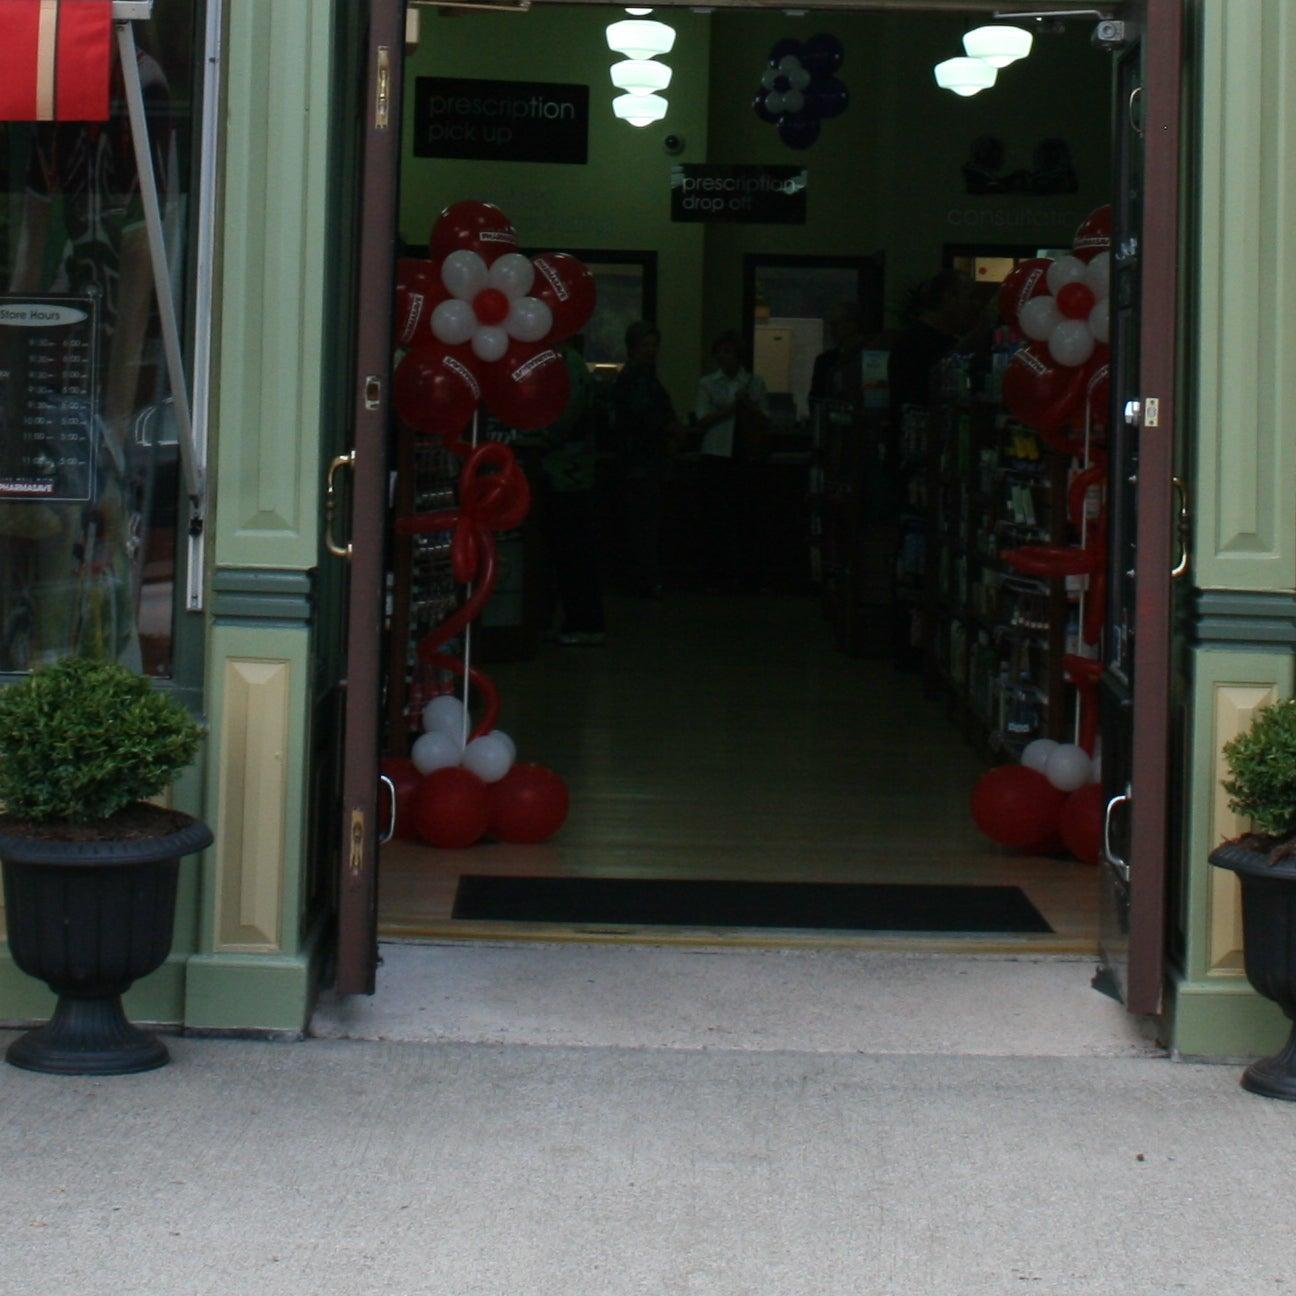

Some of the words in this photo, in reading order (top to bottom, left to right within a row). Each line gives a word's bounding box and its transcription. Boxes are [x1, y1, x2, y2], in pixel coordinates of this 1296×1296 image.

[429, 95, 576, 120] prescription
[429, 121, 477, 145] pick
[482, 126, 513, 145] up
[682, 175, 795, 194] prescription
[682, 193, 724, 212] drop
[0, 309, 27, 320] Store
[30, 310, 60, 321] Hours
